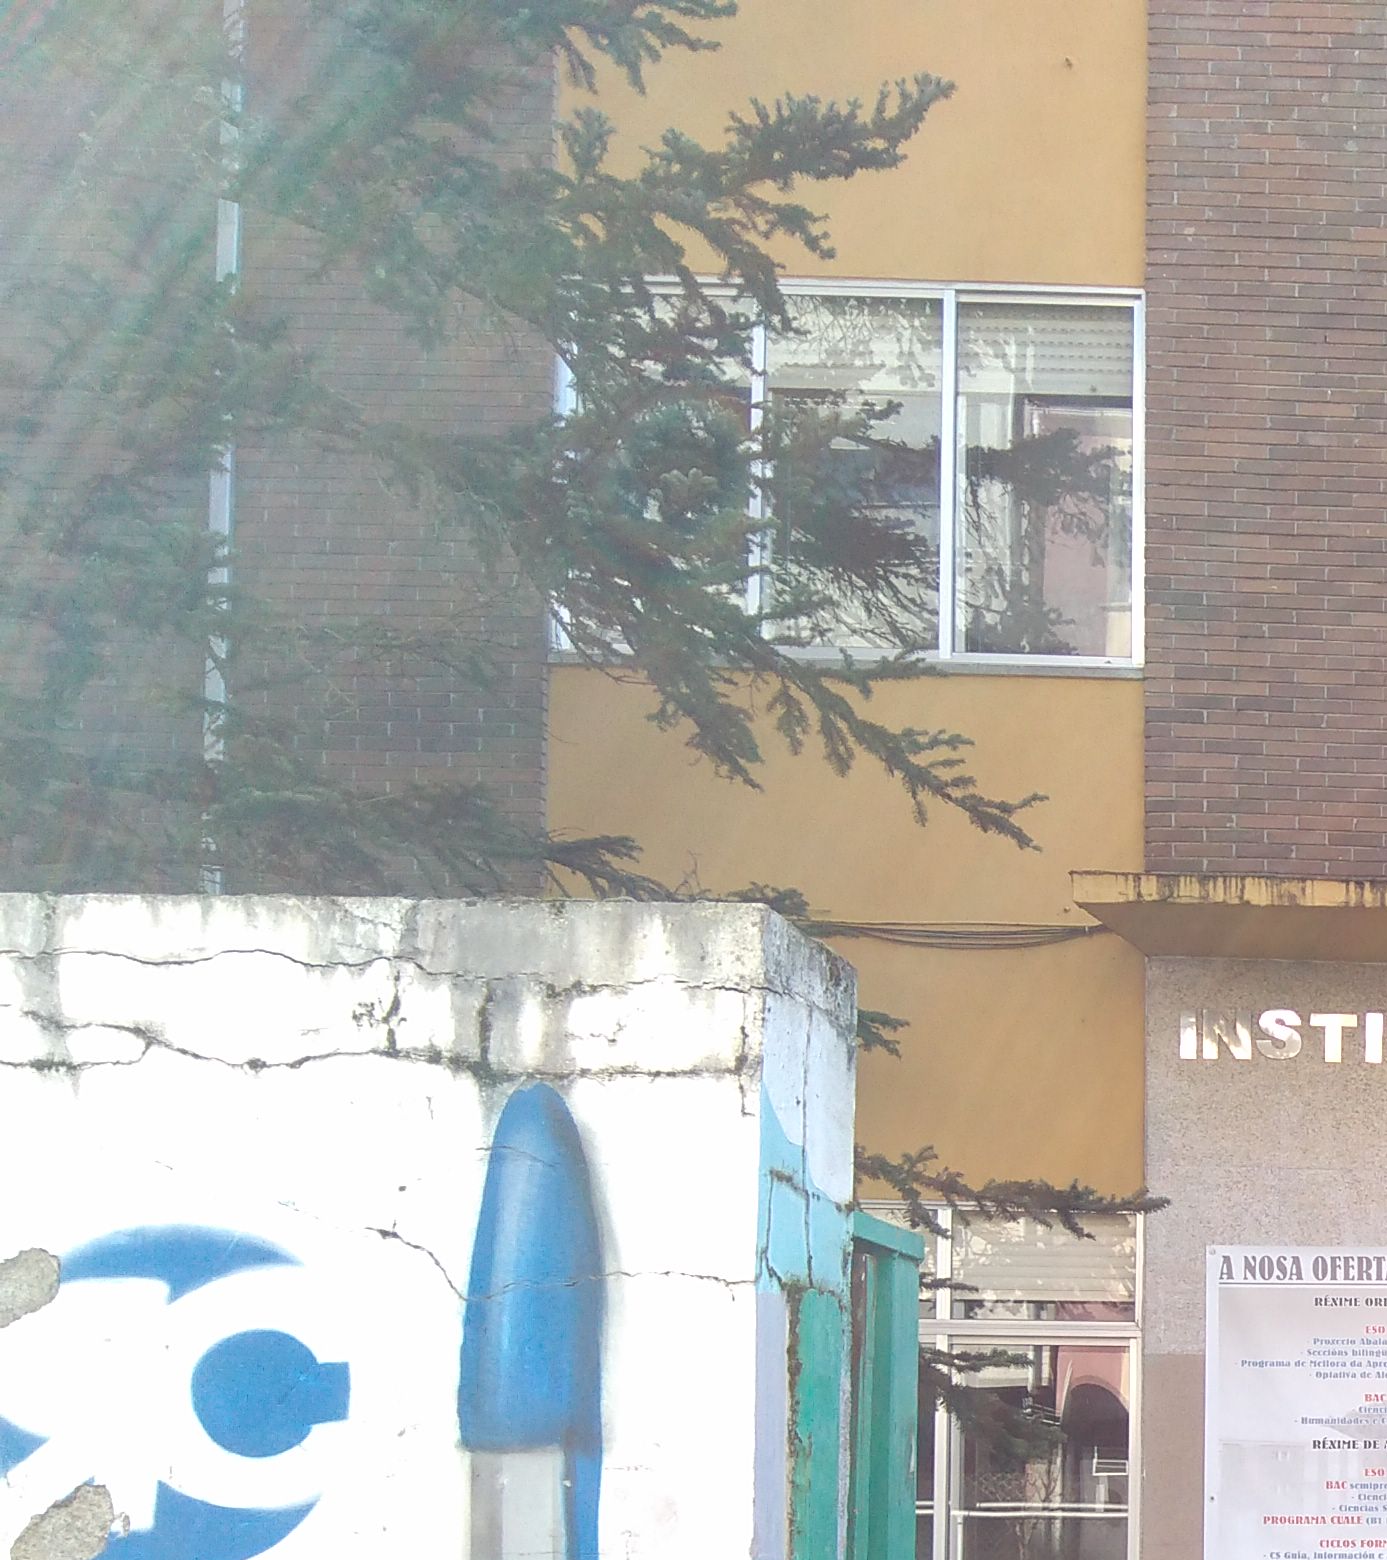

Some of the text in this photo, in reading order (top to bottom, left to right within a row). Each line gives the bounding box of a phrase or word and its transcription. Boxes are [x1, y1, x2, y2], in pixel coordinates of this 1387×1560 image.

[1219, 1255, 1235, 1281] A
[1243, 1255, 1304, 1281] NOSA
[1314, 1295, 1360, 1307] RÉXIME
[1365, 1325, 1386, 1335] ESO
[1241, 1359, 1291, 1369] Programa
[1294, 1359, 1307, 1368] de
[1360, 1371, 1373, 1379] de
[1364, 1394, 1387, 1403] BAC
[1312, 1437, 1360, 1450] RÉXIME
[1363, 1440, 1381, 1450] DE
[1364, 1468, 1386, 1477] ESO
[1325, 1480, 1348, 1490] BAC
[1339, 1504, 1379, 1512] Ciencias
[1263, 1516, 1327, 1525] PROGRAMA
[1330, 1516, 1363, 1525] CUALE
[1319, 1539, 1356, 1548] CICLOS
[1269, 1551, 1281, 1559] CS
